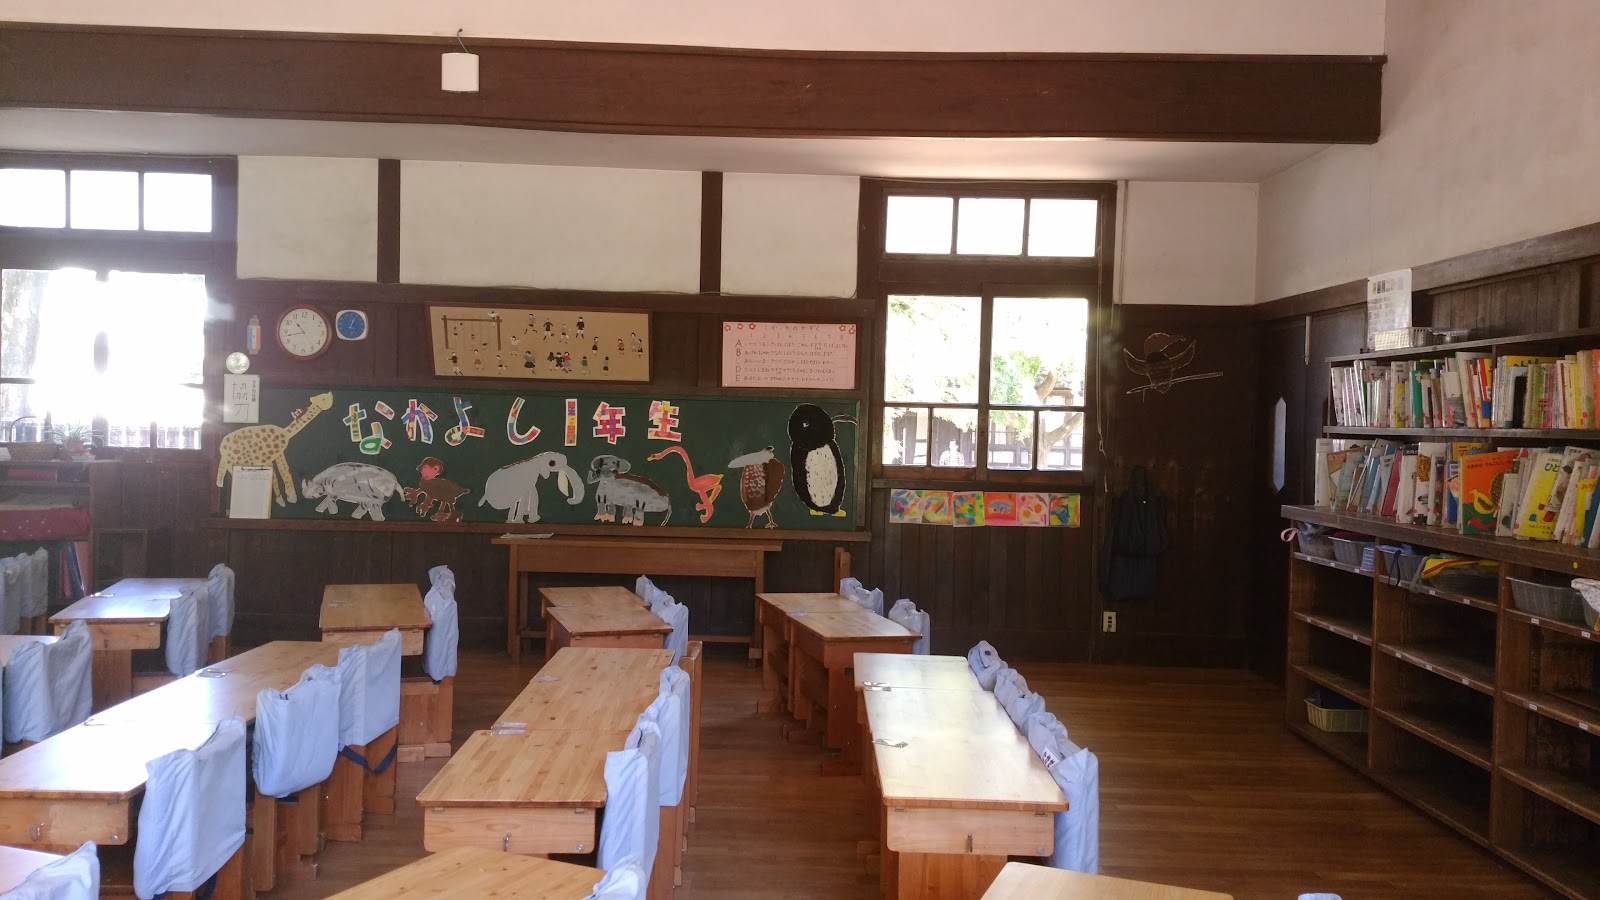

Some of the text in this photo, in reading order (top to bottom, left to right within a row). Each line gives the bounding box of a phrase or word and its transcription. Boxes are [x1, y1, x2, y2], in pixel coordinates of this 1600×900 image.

[735, 340, 743, 348] A
[736, 348, 742, 356] B
[232, 381, 250, 421] 協力
